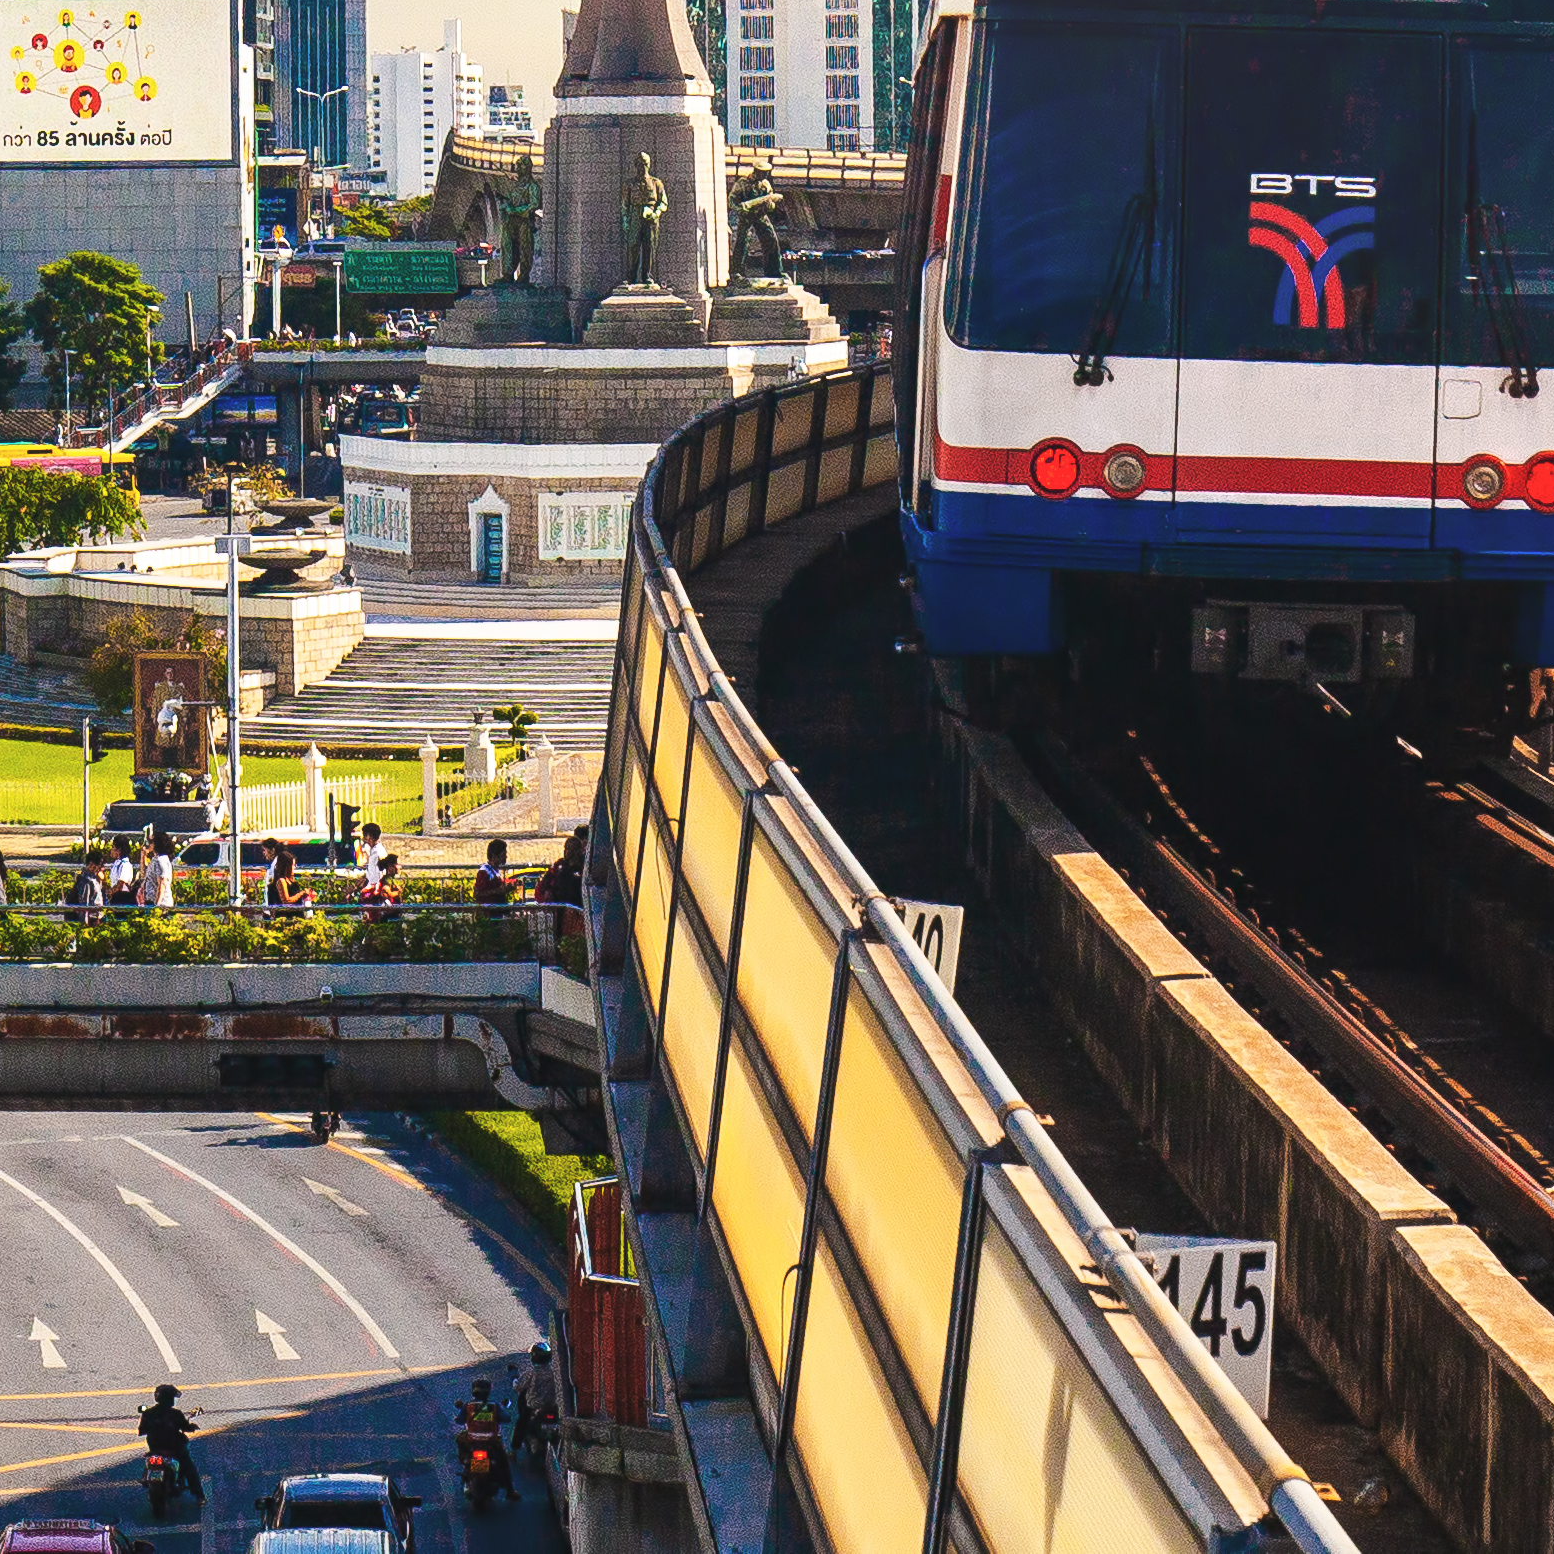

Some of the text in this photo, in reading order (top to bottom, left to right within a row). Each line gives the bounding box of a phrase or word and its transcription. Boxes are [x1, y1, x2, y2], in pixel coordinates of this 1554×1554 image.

[3, 120, 173, 147] กว่า 85 ล้านครั้ง ต่อปี
[1250, 173, 1376, 198] BTS
[1159, 1251, 1266, 1357] 145
